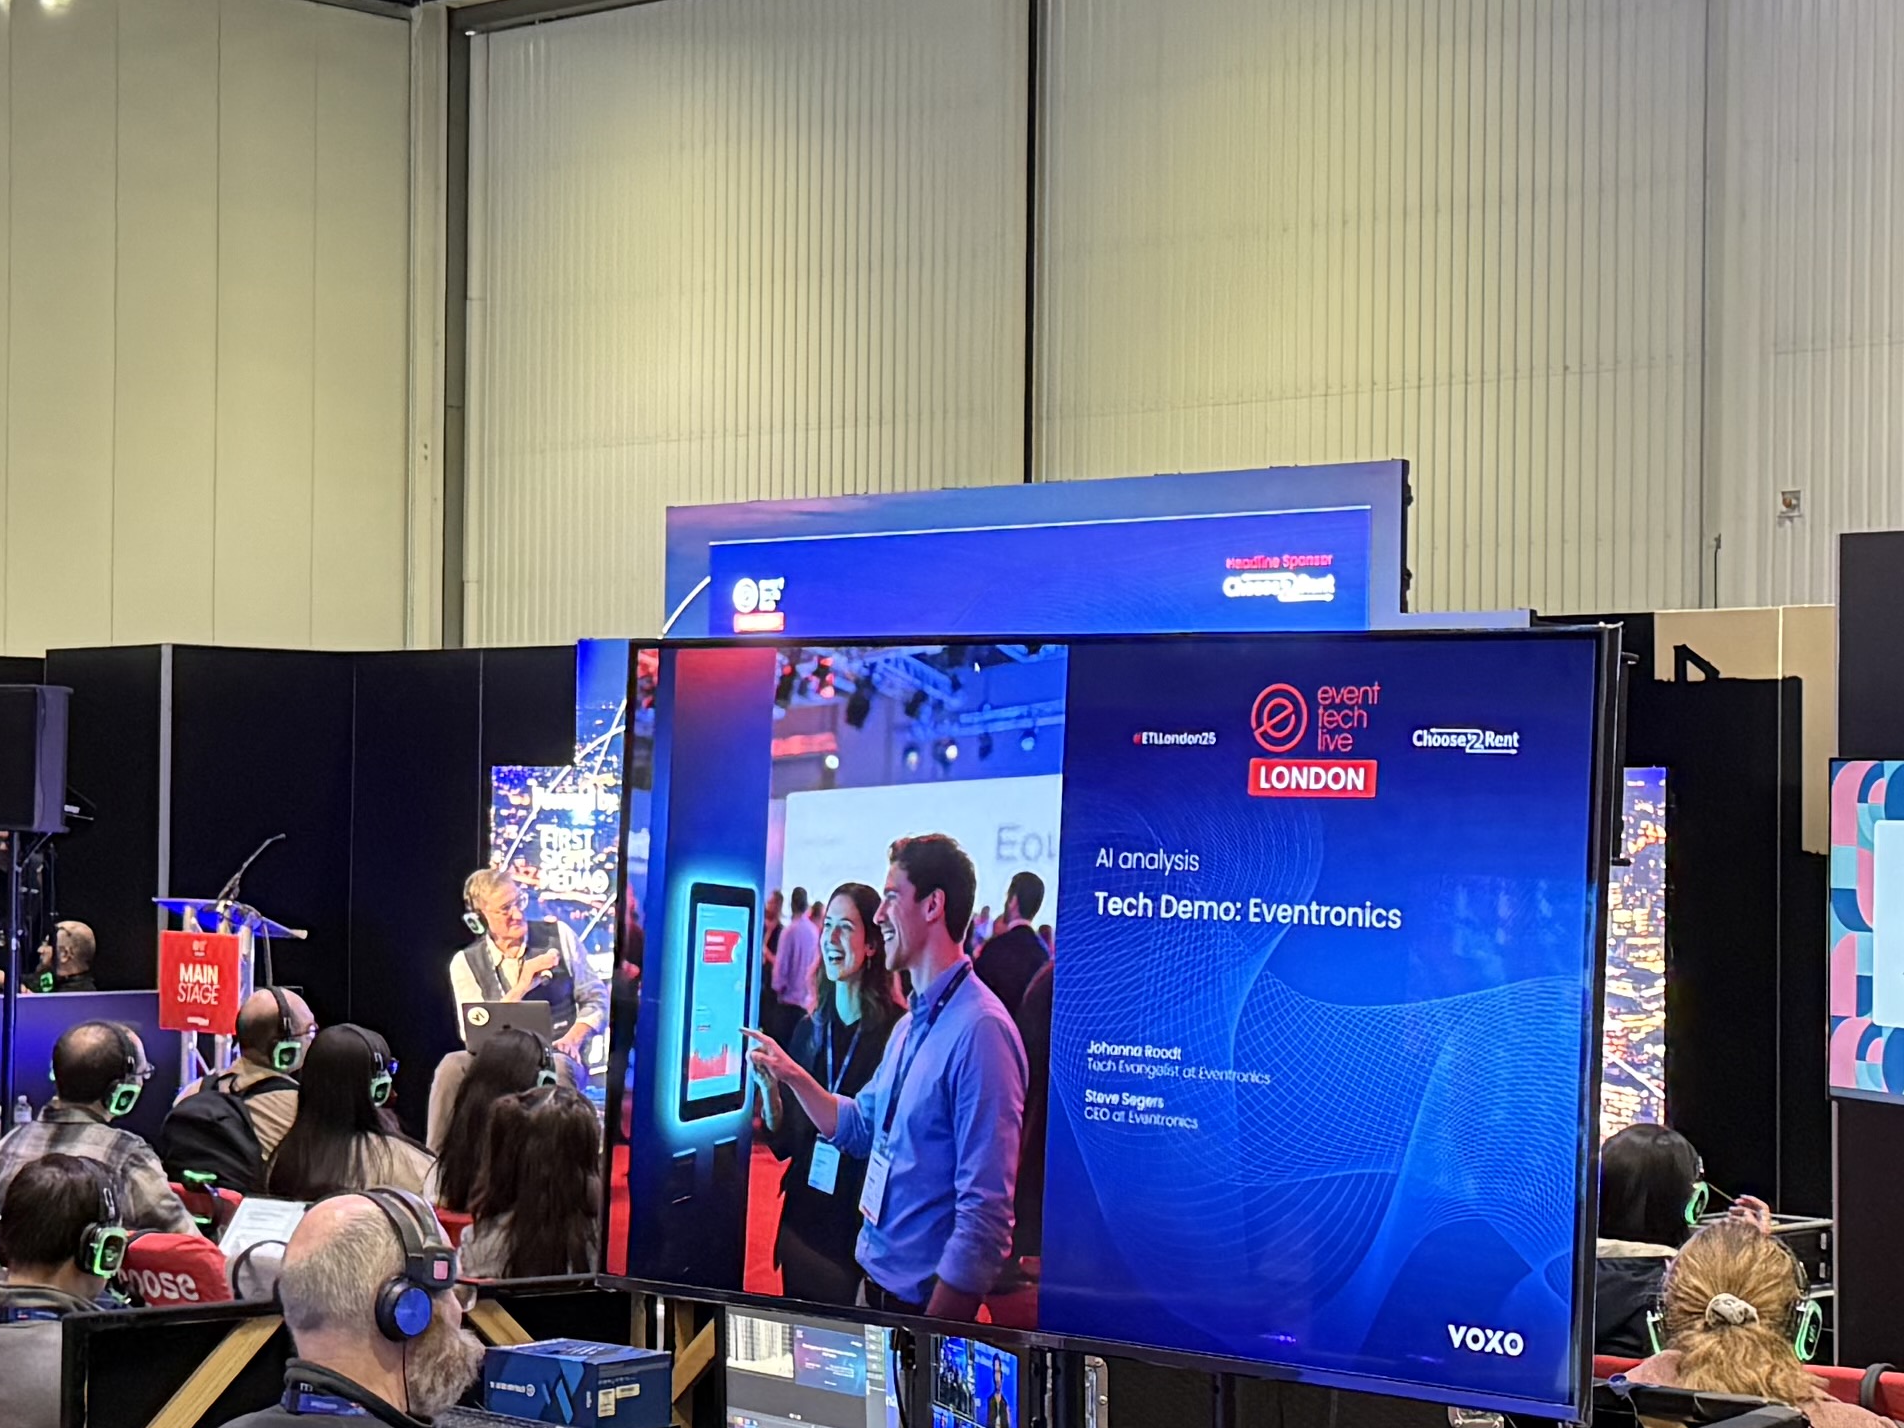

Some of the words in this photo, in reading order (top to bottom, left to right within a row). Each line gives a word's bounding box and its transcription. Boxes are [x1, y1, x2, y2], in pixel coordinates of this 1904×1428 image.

[1318, 681, 1381, 705] event
[1318, 705, 1367, 729] tech
[1318, 729, 1353, 752] live
[1259, 765, 1365, 791] LONDON
[539, 827, 595, 851] FIRST
[1095, 848, 1114, 869] AI
[1119, 847, 1200, 876] analysis
[1094, 890, 1154, 920] Tech
[1160, 893, 1242, 923] Demo:
[1248, 897, 1402, 930] Eventronics
[179, 962, 219, 984] MAIN
[177, 982, 220, 1005] STAGE
[1087, 1041, 1142, 1057] Johanna
[1144, 1045, 1182, 1060] Roodt
[1087, 1058, 1116, 1072] Tech
[1119, 1060, 1180, 1079] Evangelist
[1183, 1065, 1197, 1079] at
[1198, 1067, 1271, 1084] Eventronics
[1085, 1089, 1119, 1105] Steve
[1122, 1093, 1164, 1110] Segers
[1084, 1106, 1110, 1121] CEO
[1112, 1110, 1125, 1122] at
[1129, 1110, 1199, 1129] Eventronics
[1447, 1324, 1524, 1357] VOXO
